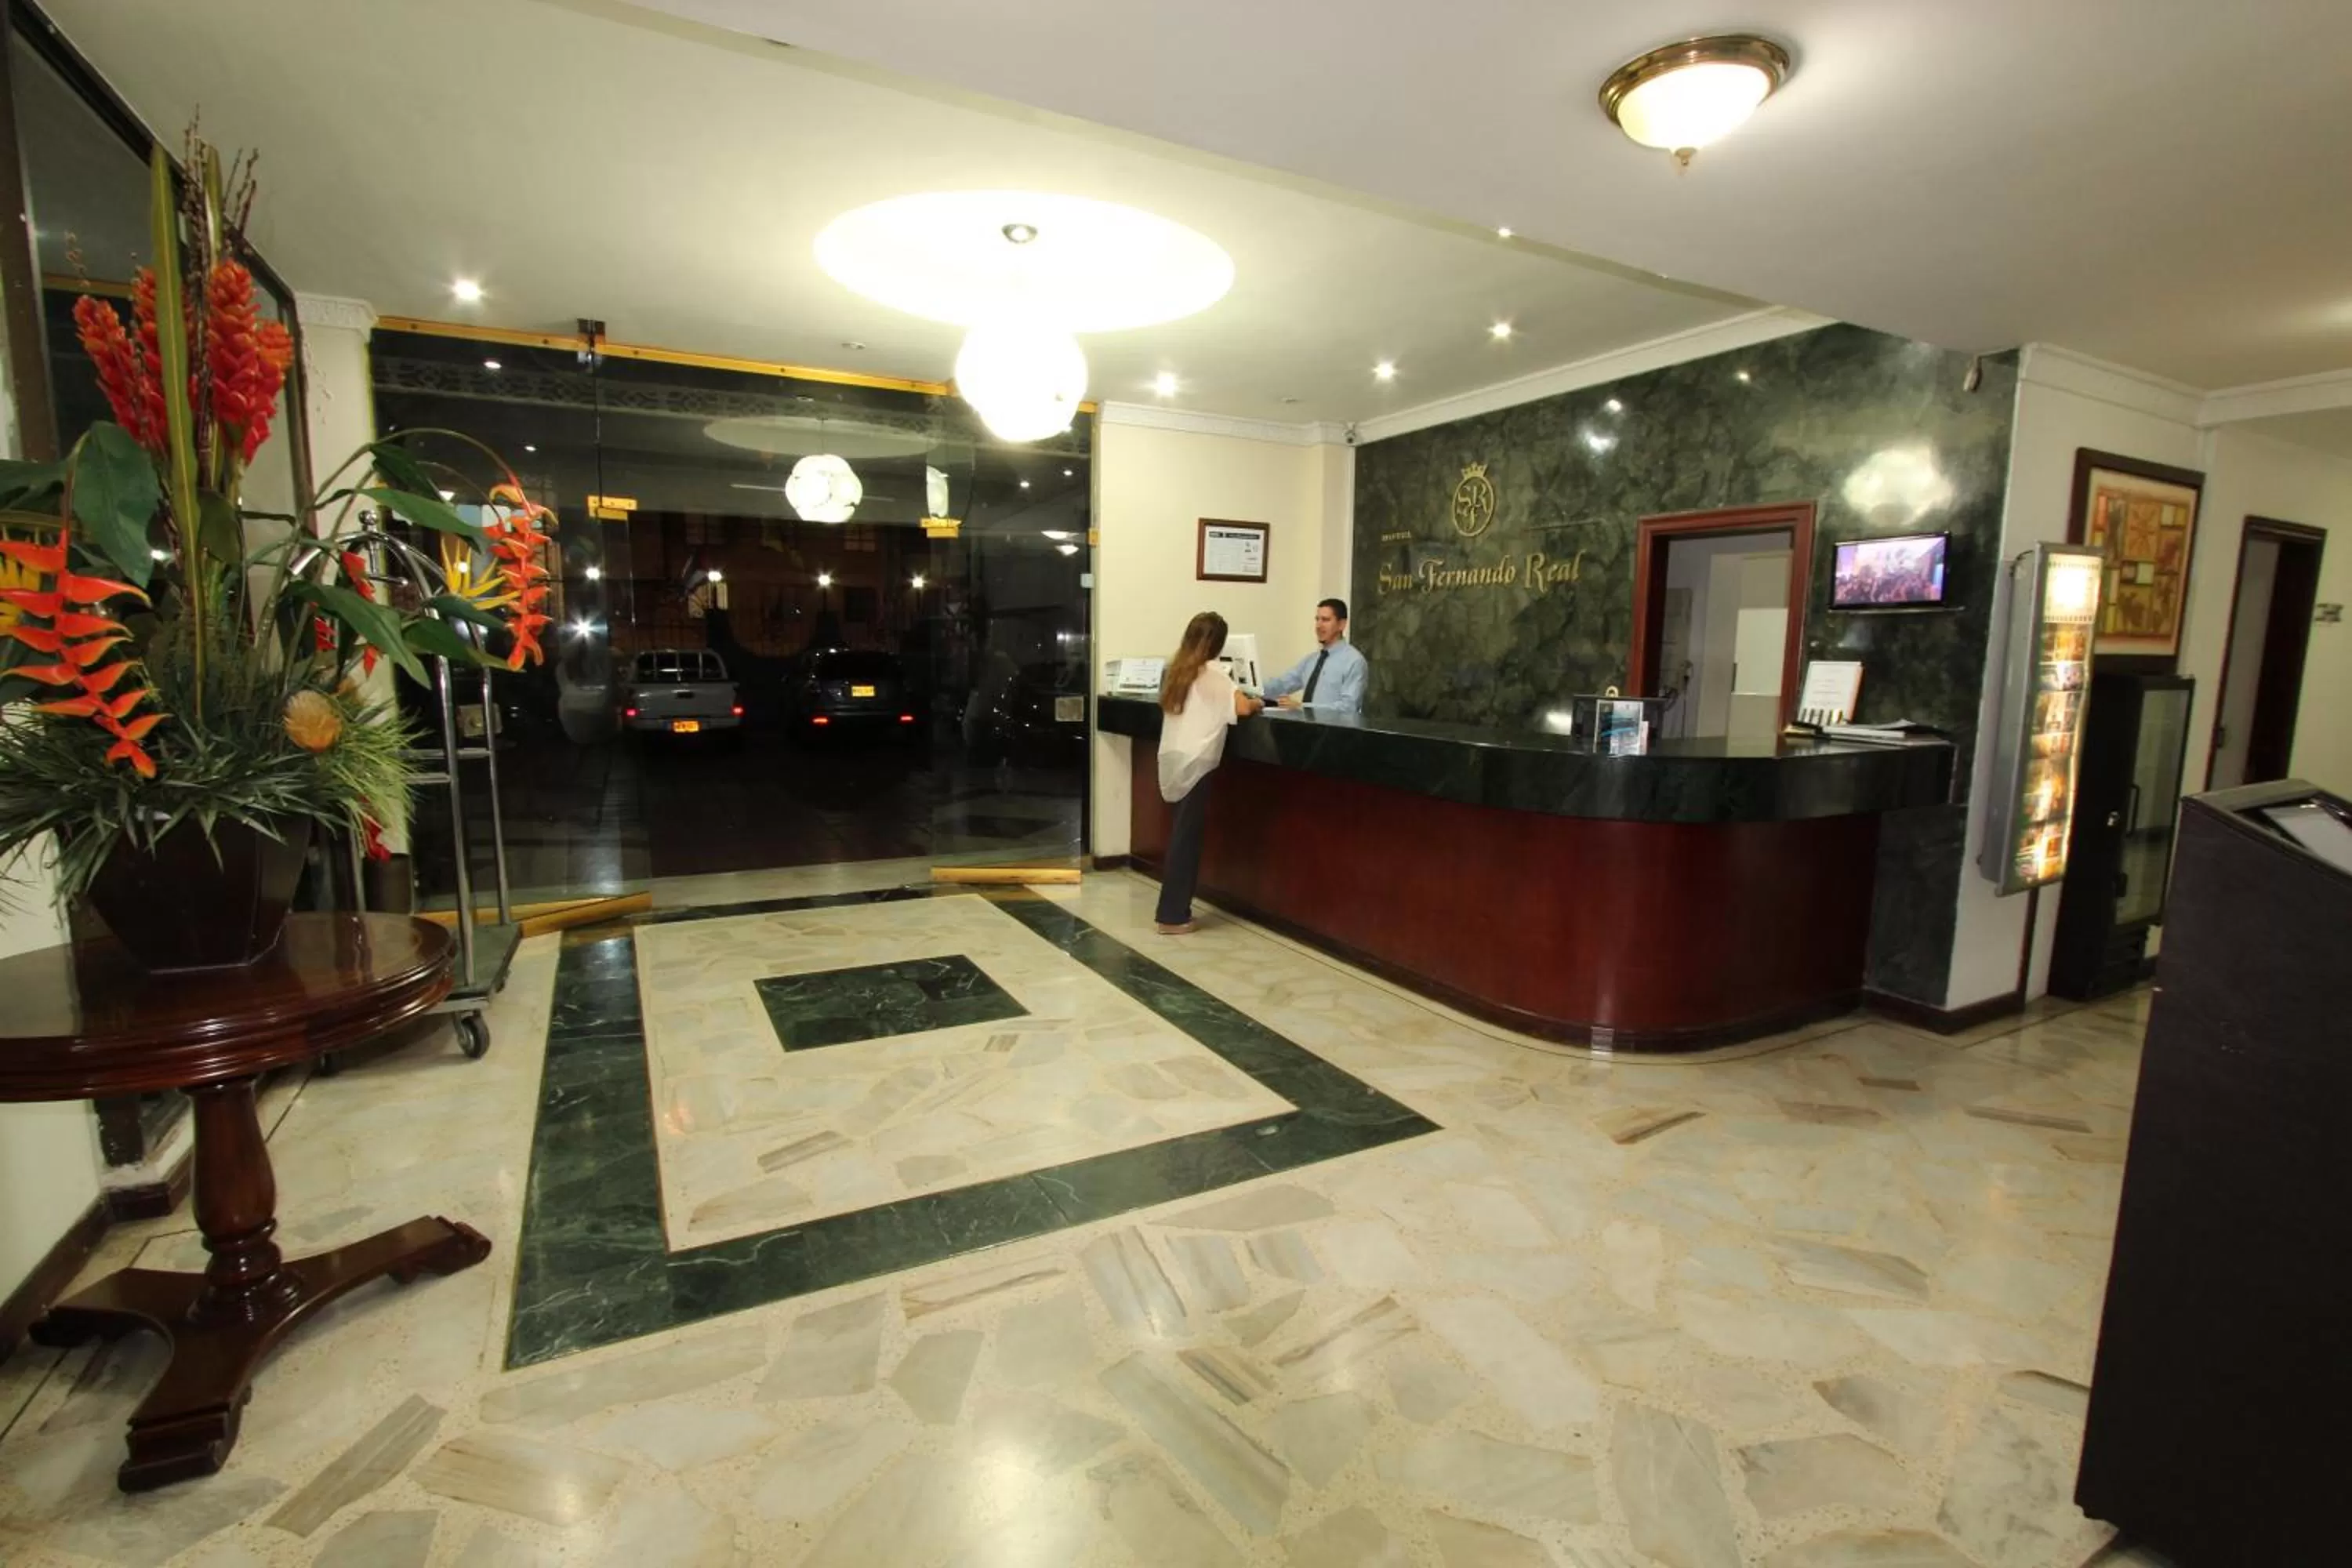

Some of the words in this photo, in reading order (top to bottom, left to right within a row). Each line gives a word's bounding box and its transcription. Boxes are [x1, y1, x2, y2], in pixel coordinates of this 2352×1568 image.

[1377, 561, 1413, 594] San
[1417, 554, 1516, 593] Fernando
[1524, 550, 1586, 593] Real
